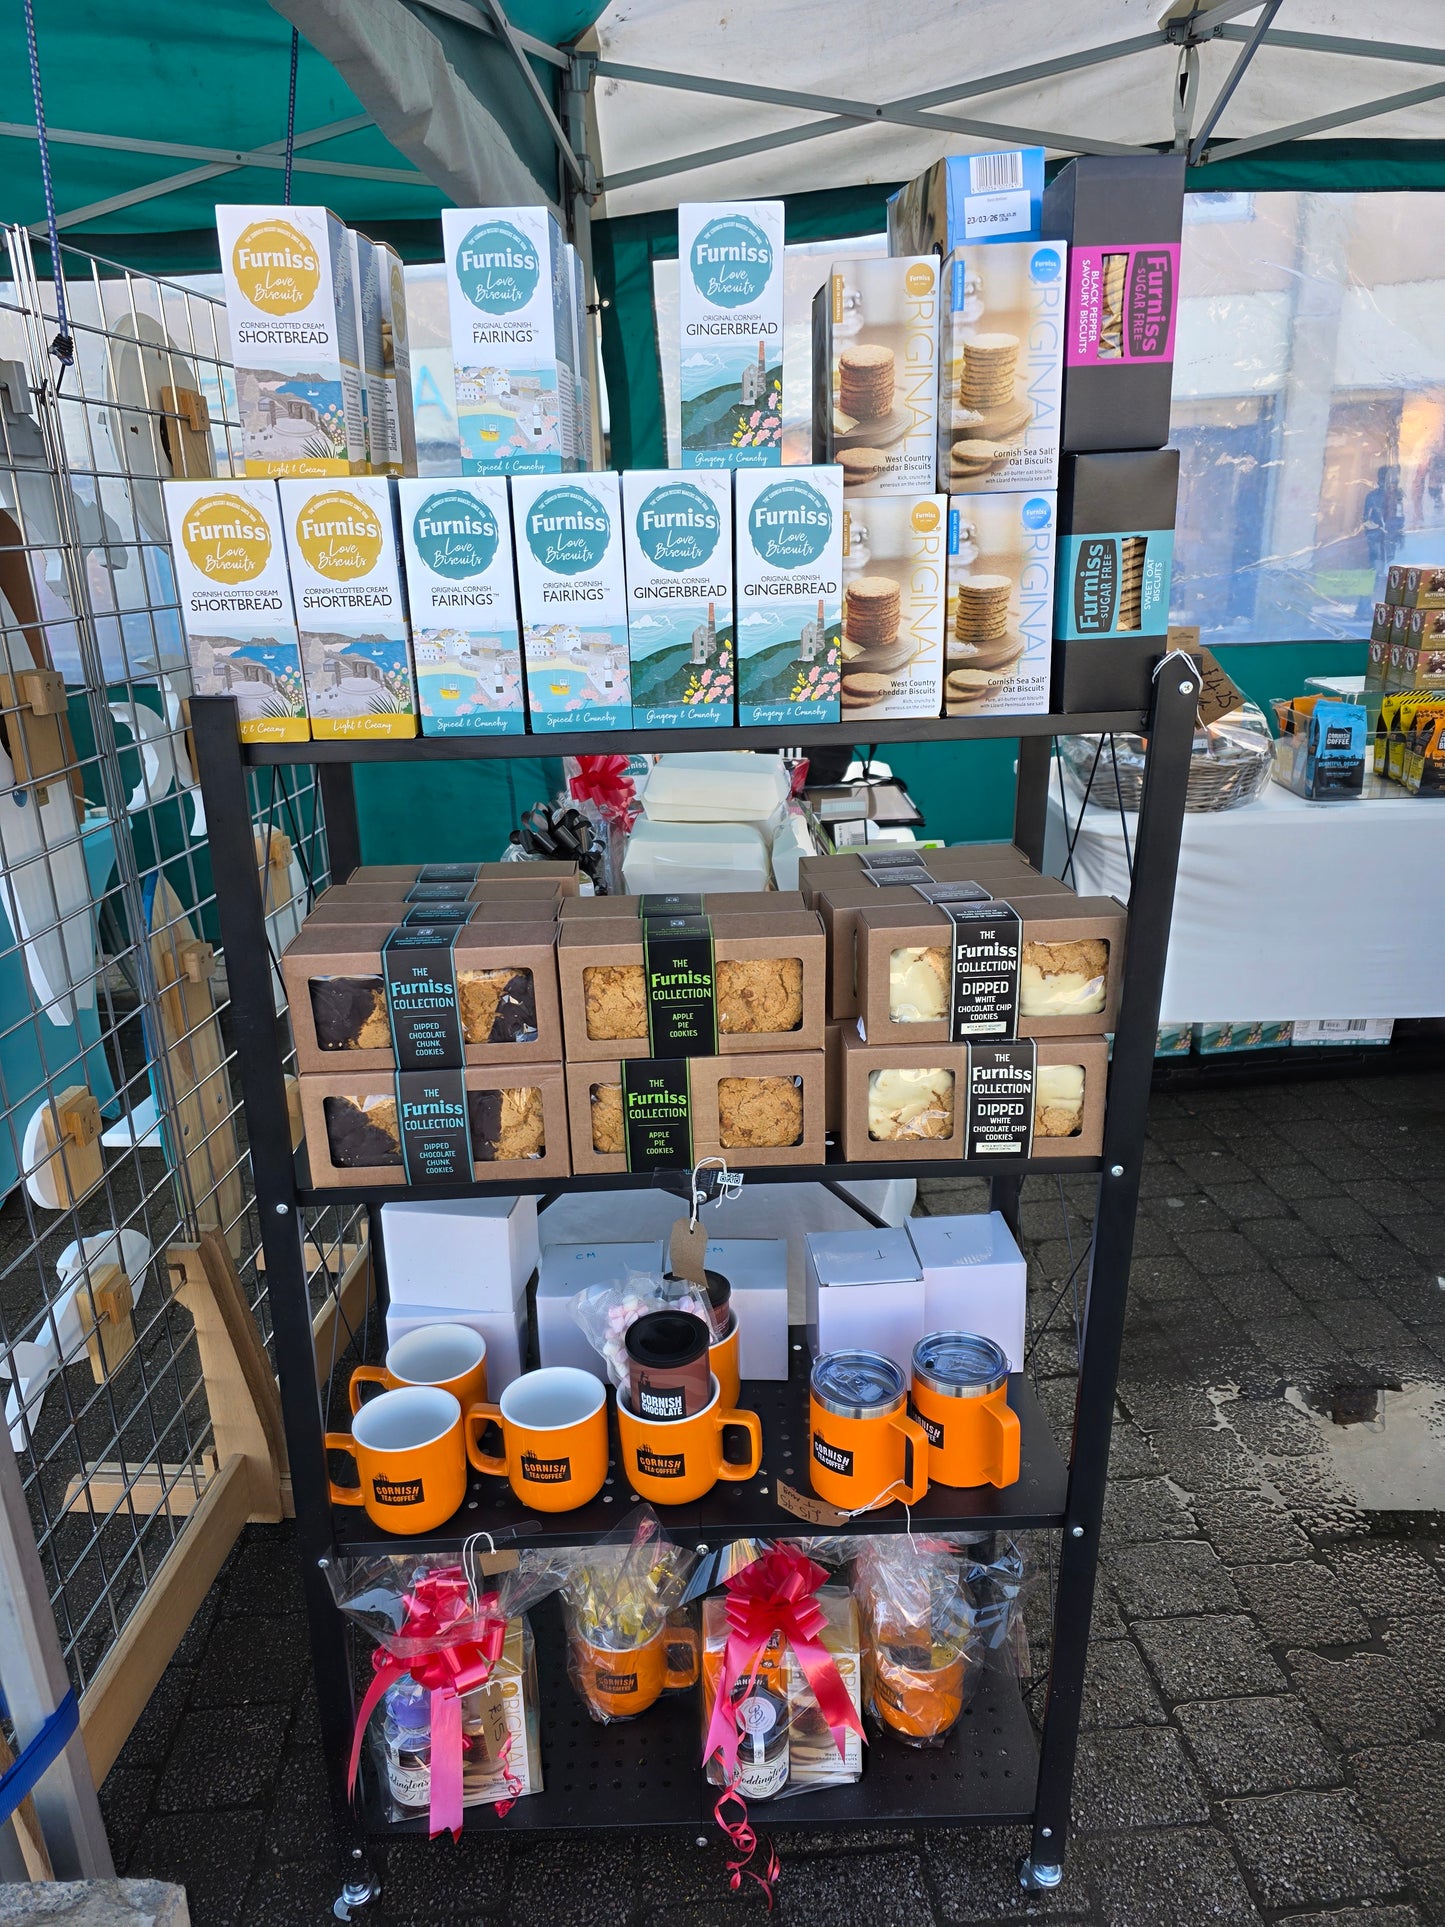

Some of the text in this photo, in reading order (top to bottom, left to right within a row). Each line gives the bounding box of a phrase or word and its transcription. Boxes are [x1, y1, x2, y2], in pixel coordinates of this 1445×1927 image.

[967, 215, 998, 224] 23/03/26
[238, 248, 315, 270] Furniss
[462, 248, 535, 271] Furniss
[696, 242, 768, 265] Furniss
[266, 270, 295, 288] Love
[487, 271, 514, 289] Love
[719, 265, 747, 283] Love
[253, 283, 303, 302] Biscuits
[475, 284, 523, 302] Biscuits
[707, 277, 755, 295] Biscuits
[1078, 259, 1091, 354] SAVOURY BISCUITS
[1087, 270, 1099, 342] BLACK PEPPER
[1132, 267, 1147, 341] SUGAR FREE
[1142, 256, 1167, 352] Furniss
[239, 330, 328, 344] SHORTBREAD
[686, 322, 777, 336] GINGERBREAD
[885, 454, 931, 464] West Country
[993, 449, 1022, 458] Cornish
[1024, 449, 1036, 457] Sea
[1025, 457, 1053, 465] Biscuits
[903, 463, 931, 471] Biscuits
[532, 512, 606, 534] Furniss
[642, 508, 716, 530] Furniss
[755, 505, 828, 527] Furniss
[187, 520, 266, 542] Furniss
[301, 517, 378, 539] Furniss
[418, 517, 494, 538] Furniss
[778, 527, 808, 544] Love
[444, 538, 473, 554] Love
[556, 533, 586, 550] Love
[666, 530, 695, 547] Love
[217, 541, 246, 557] Love
[329, 539, 358, 555] Love
[546, 546, 594, 564] Biscuits
[655, 543, 703, 560] Biscuits
[765, 541, 815, 558] Biscuits
[205, 554, 256, 572] Biscuits
[318, 552, 367, 569] Biscuits
[434, 551, 483, 568] Biscuits
[744, 583, 837, 596] GINGERBREAD
[1080, 543, 1104, 630] Furniss
[1100, 554, 1112, 618] SUGAR FREE
[1144, 558, 1154, 610] SWEET OAT
[1152, 562, 1163, 602] BISCUITS
[634, 585, 727, 599] GINGERBREAD
[191, 599, 282, 612] SHORTBREAD
[303, 595, 392, 609] SHORTBREAD
[909, 680, 936, 688] Country
[988, 678, 1014, 686] Cornish
[1016, 677, 1029, 685] Sea
[878, 687, 935, 696] Cheddar Biscuits
[333, 719, 357, 733] Light
[365, 720, 392, 733] Creamy
[980, 931, 995, 939] THE
[957, 942, 1017, 960] Furniss
[672, 960, 688, 968] THE
[957, 961, 1016, 973] COLLECTION
[412, 968, 428, 977] THE
[652, 970, 711, 987] Furniss
[391, 980, 453, 997] Furniss
[652, 988, 711, 1001] COLLECTION
[962, 982, 1009, 995] DIPPED
[393, 998, 454, 1010] COLLECTION
[970, 1013, 998, 1021] COOKIES
[409, 1031, 446, 1039] CHOCOLATE
[669, 1030, 698, 1038] COOKIES
[416, 1048, 444, 1056] COOKIES
[995, 1053, 1010, 1062] THE
[973, 1065, 1032, 1081] Furniss
[649, 1079, 664, 1087] THE
[972, 1083, 1031, 1094] COLLECTION
[424, 1089, 439, 1097] THE
[628, 1090, 686, 1106] Furniss
[403, 1100, 463, 1118] Furniss
[629, 1108, 687, 1119] COLLECTION
[977, 1104, 1024, 1116] DIPPED
[405, 1118, 464, 1131] COLLECTION
[649, 1131, 669, 1139] APPLE
[647, 1147, 674, 1155] COOKIES
[641, 1392, 682, 1408] CORNISH
[642, 1404, 682, 1416] CHOCOLATE
[815, 1441, 849, 1466] CORNISH
[525, 1463, 567, 1473] CORNISH
[640, 1457, 681, 1468] CORNISH
[376, 1486, 419, 1496] CORNISH
